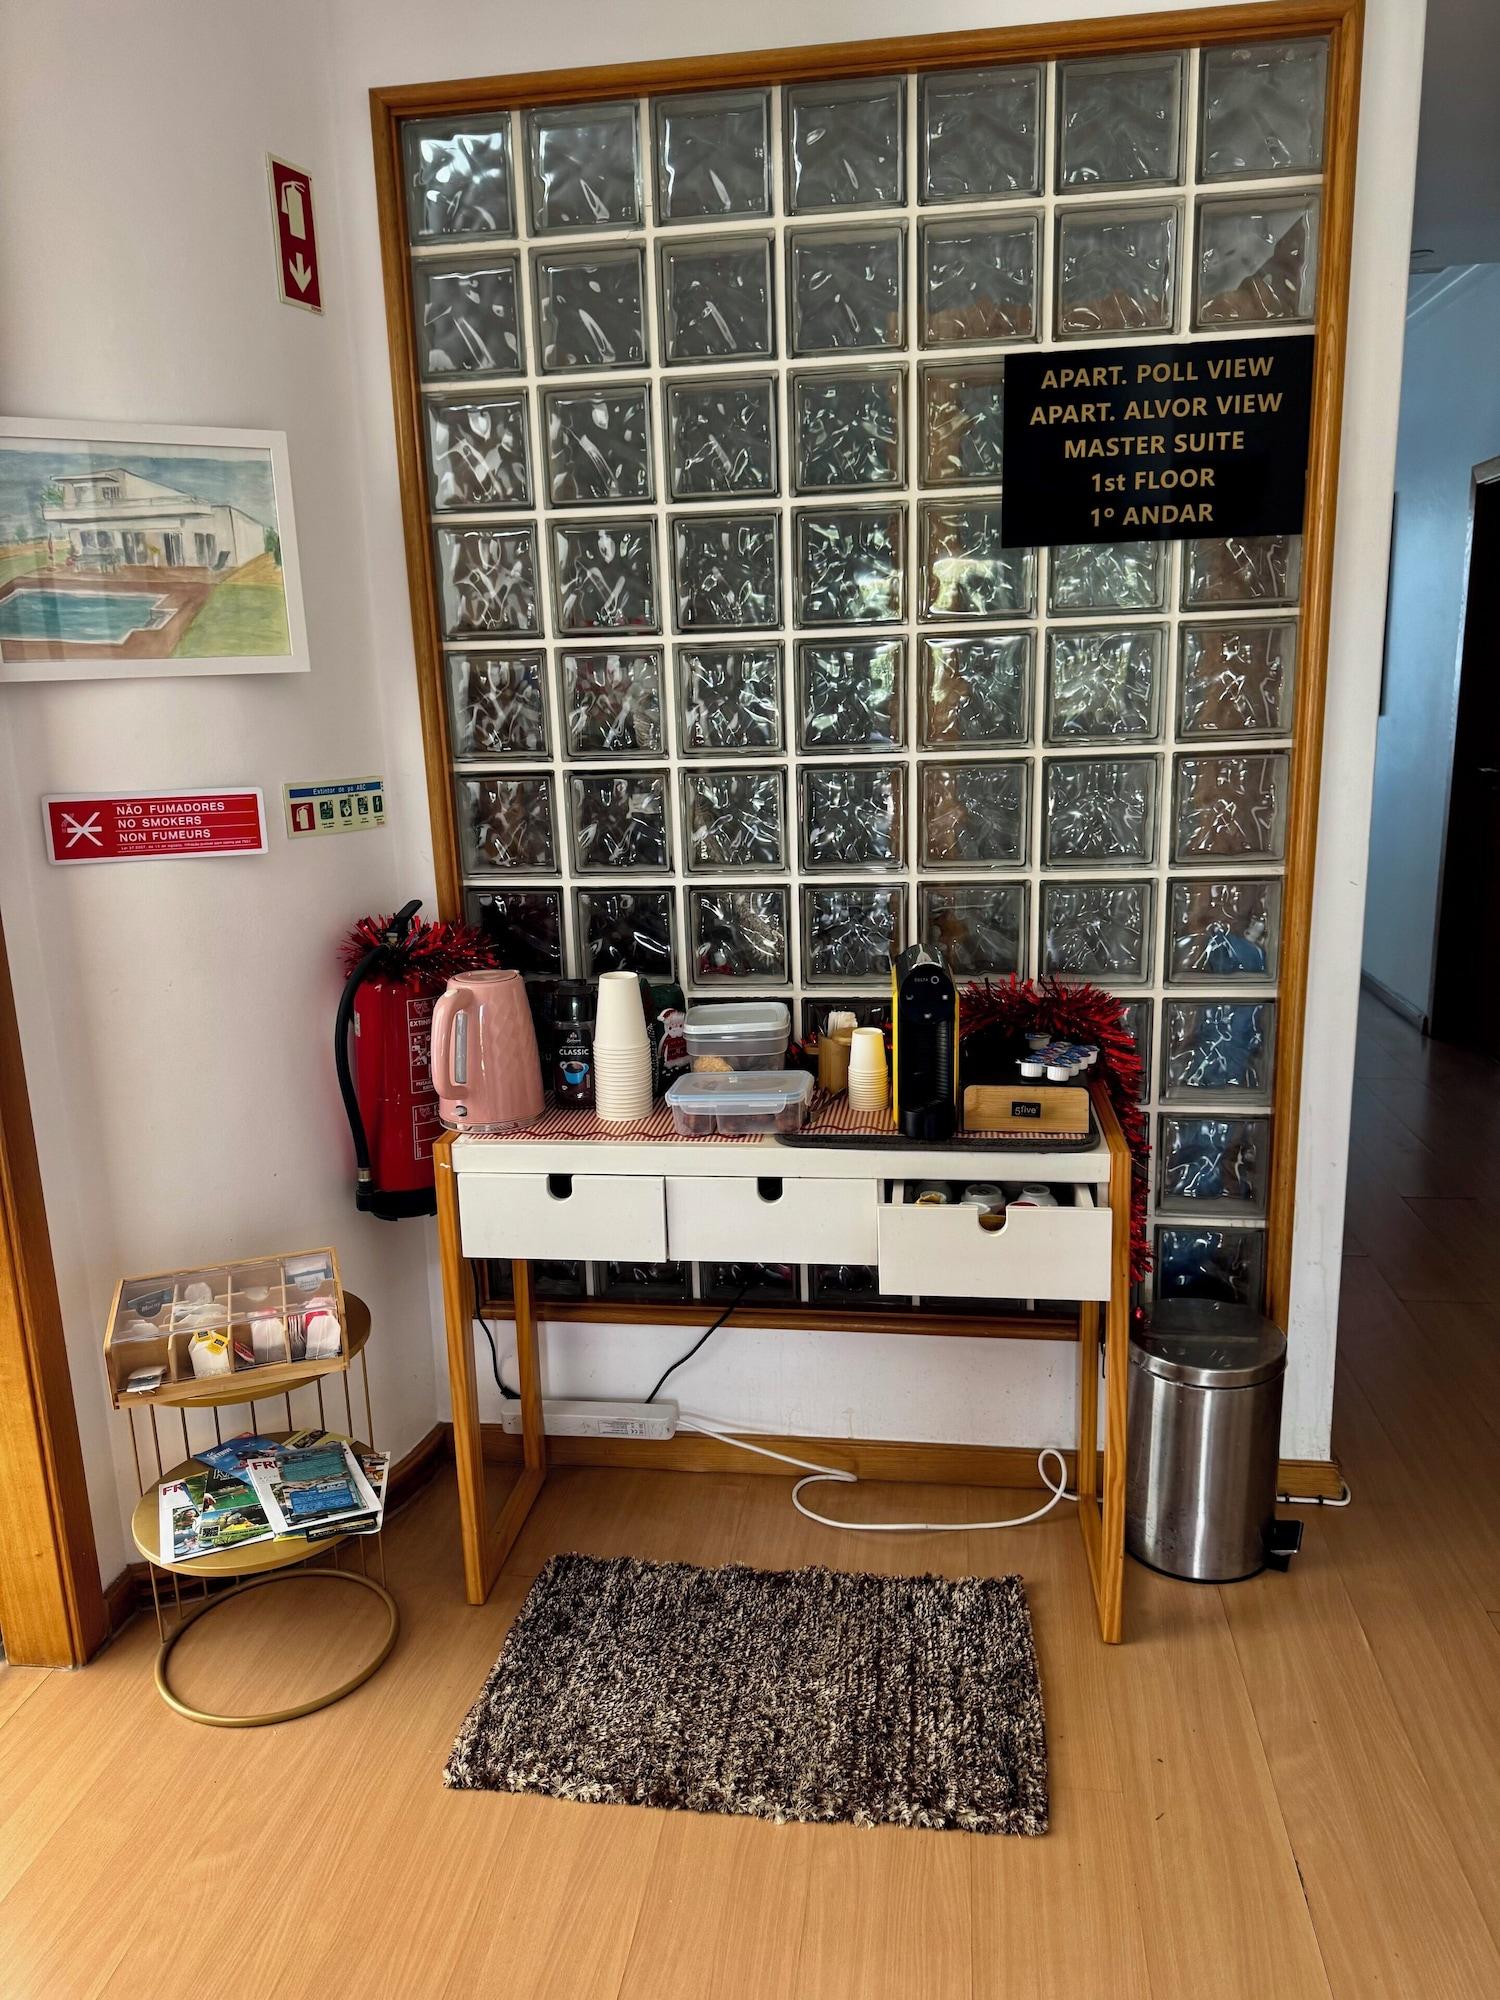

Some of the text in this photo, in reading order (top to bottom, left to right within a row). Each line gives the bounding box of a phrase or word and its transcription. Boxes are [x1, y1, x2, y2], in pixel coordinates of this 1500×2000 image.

[1040, 356, 1274, 390] APART. POLL VIEW
[1029, 392, 1283, 426] APART. ALVOR VIEW
[1064, 430, 1245, 459] MASTER SUITE
[1091, 467, 1215, 493] 1st FLOOR
[1122, 503, 1214, 526] ANDAR
[116, 801, 225, 816] NÃO FUMADORES
[118, 816, 202, 829] NO SMOKERS
[119, 828, 211, 843] NON FUMEURS
[559, 1048, 590, 1056] CLASSIC
